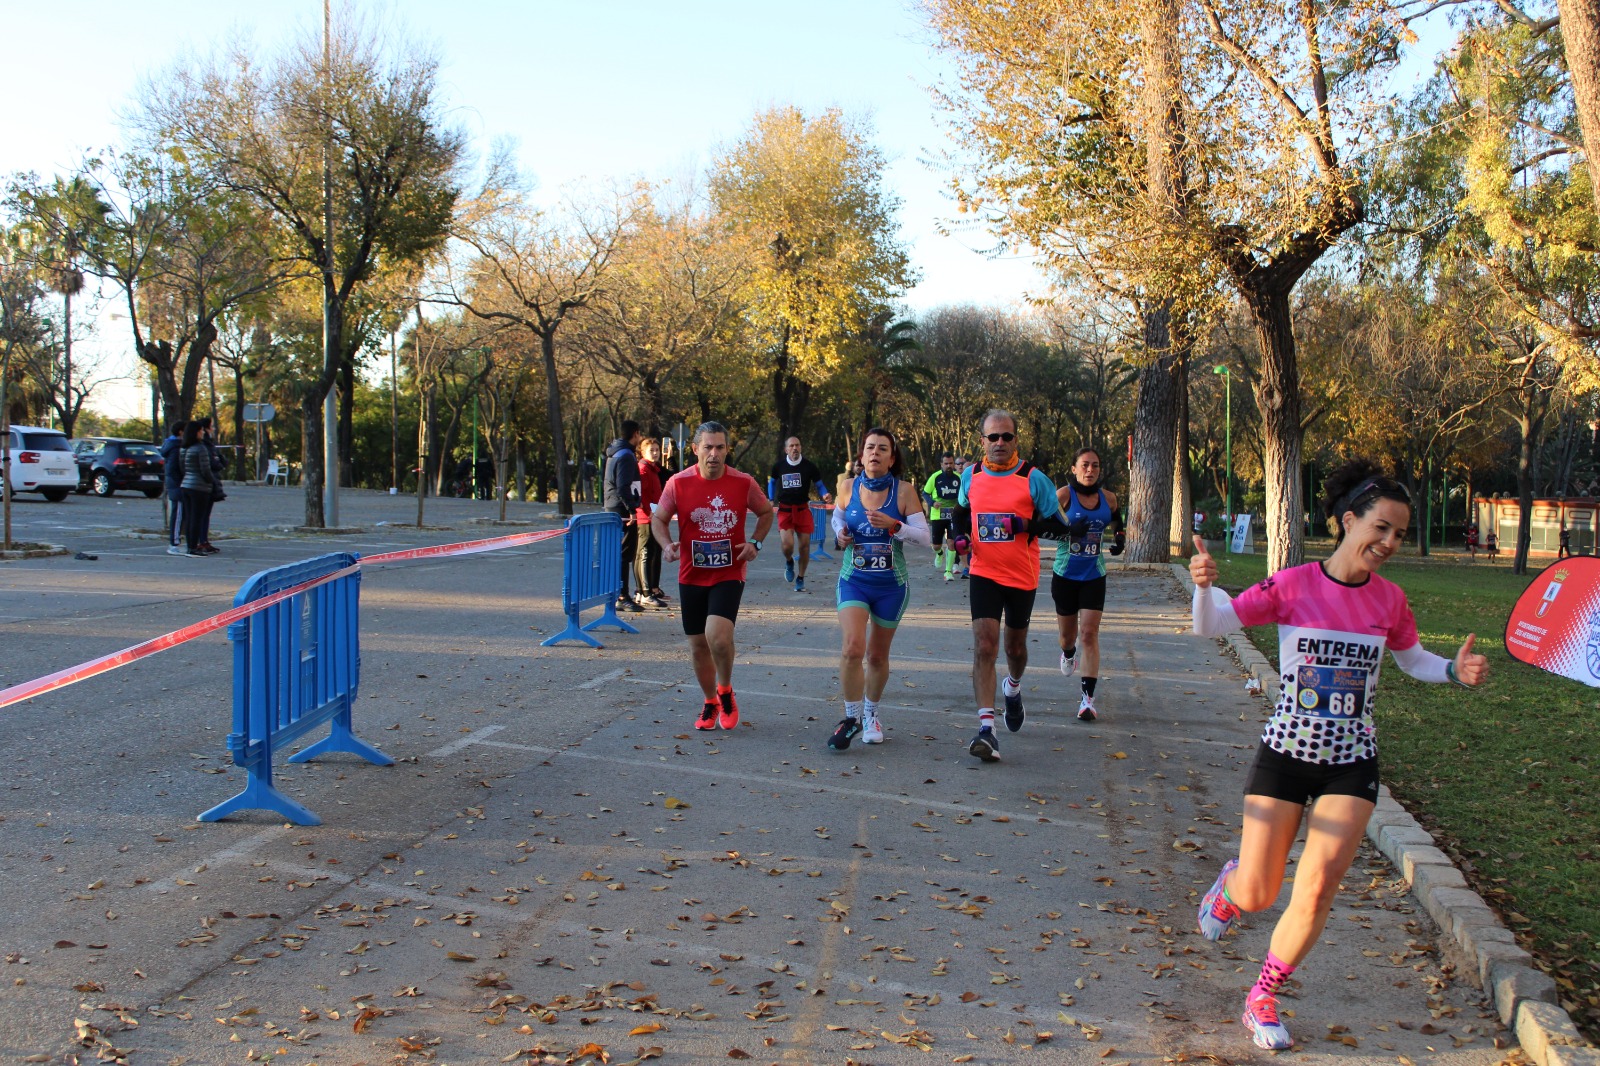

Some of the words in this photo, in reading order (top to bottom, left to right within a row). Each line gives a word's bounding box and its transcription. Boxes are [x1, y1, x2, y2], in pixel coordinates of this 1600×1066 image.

[1238, 525, 1245, 534] 8
[1084, 544, 1097, 555] 49
[707, 553, 729, 565] 125
[870, 556, 887, 569] 26
[1297, 637, 1379, 661] ENTRENA
[1329, 691, 1356, 715] 68
